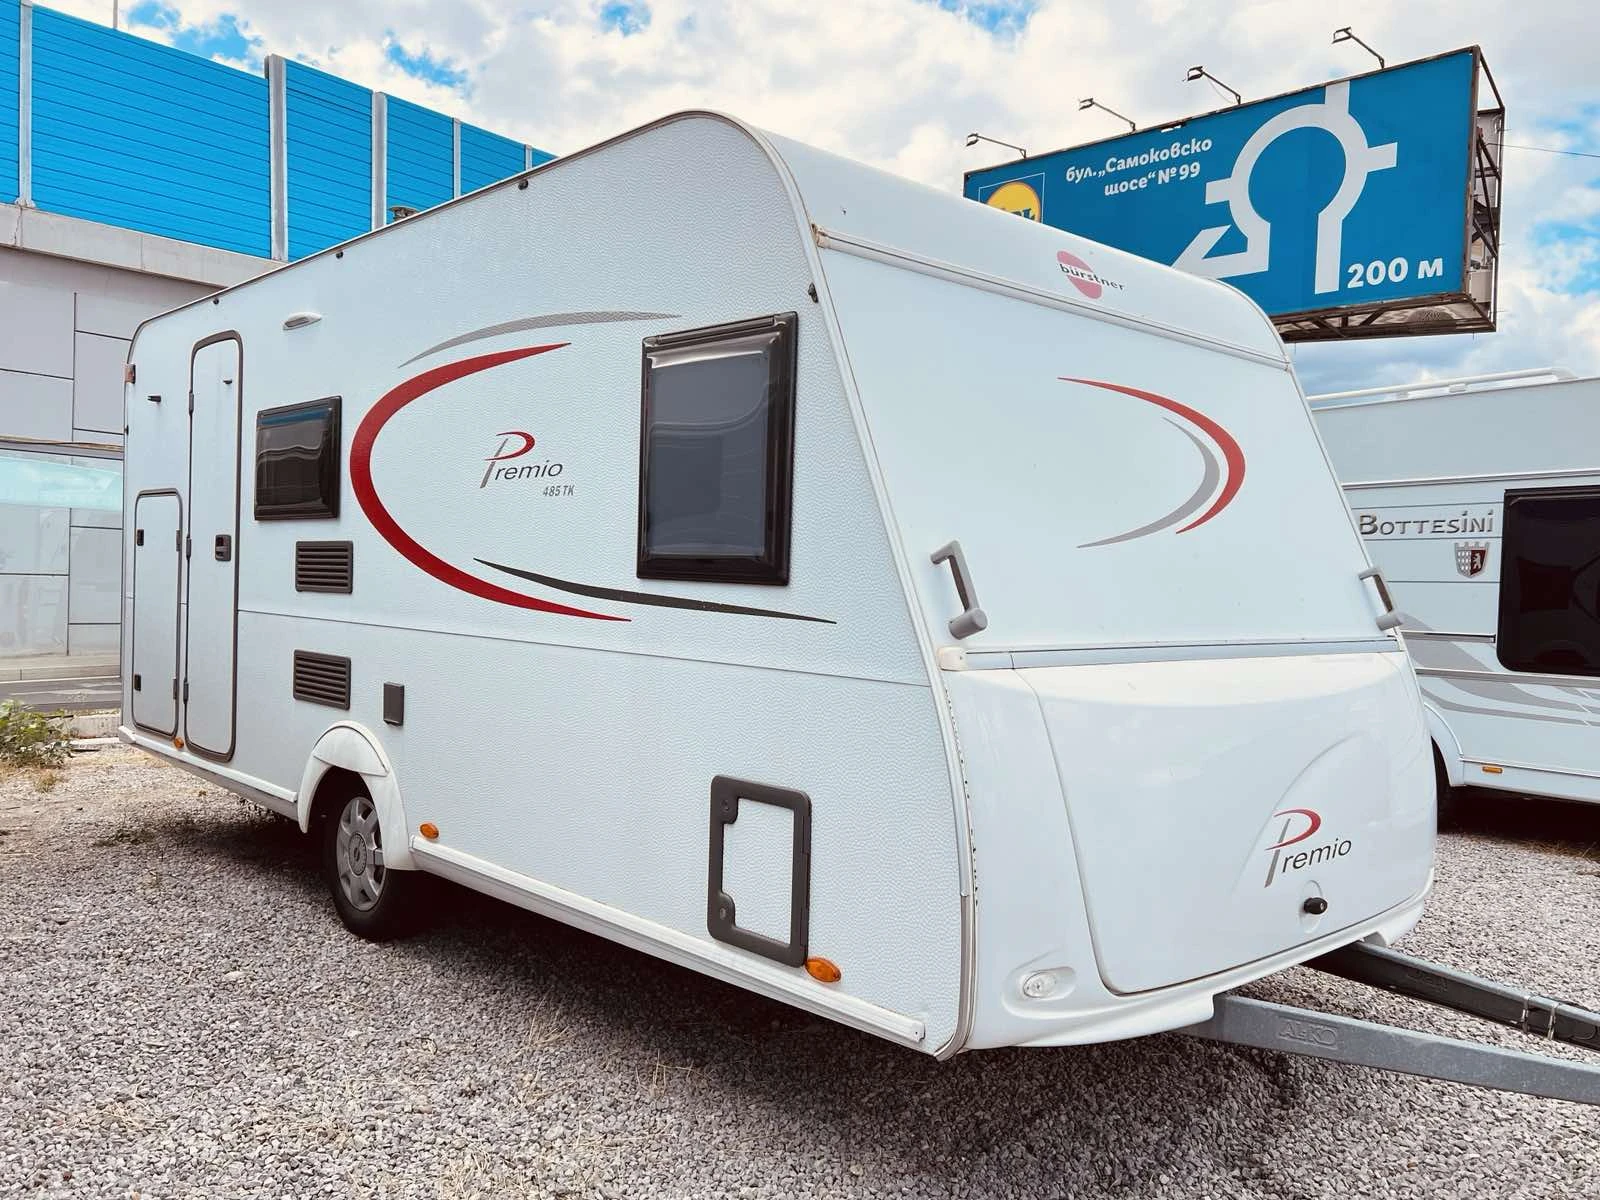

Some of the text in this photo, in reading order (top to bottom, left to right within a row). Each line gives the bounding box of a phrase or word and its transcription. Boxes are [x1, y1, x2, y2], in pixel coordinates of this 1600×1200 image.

[1059, 262, 1126, 291] bürstner
[1347, 256, 1409, 289] 200
[479, 430, 564, 489] Premio
[542, 485, 561, 497] 485
[1264, 808, 1353, 889] Premio
